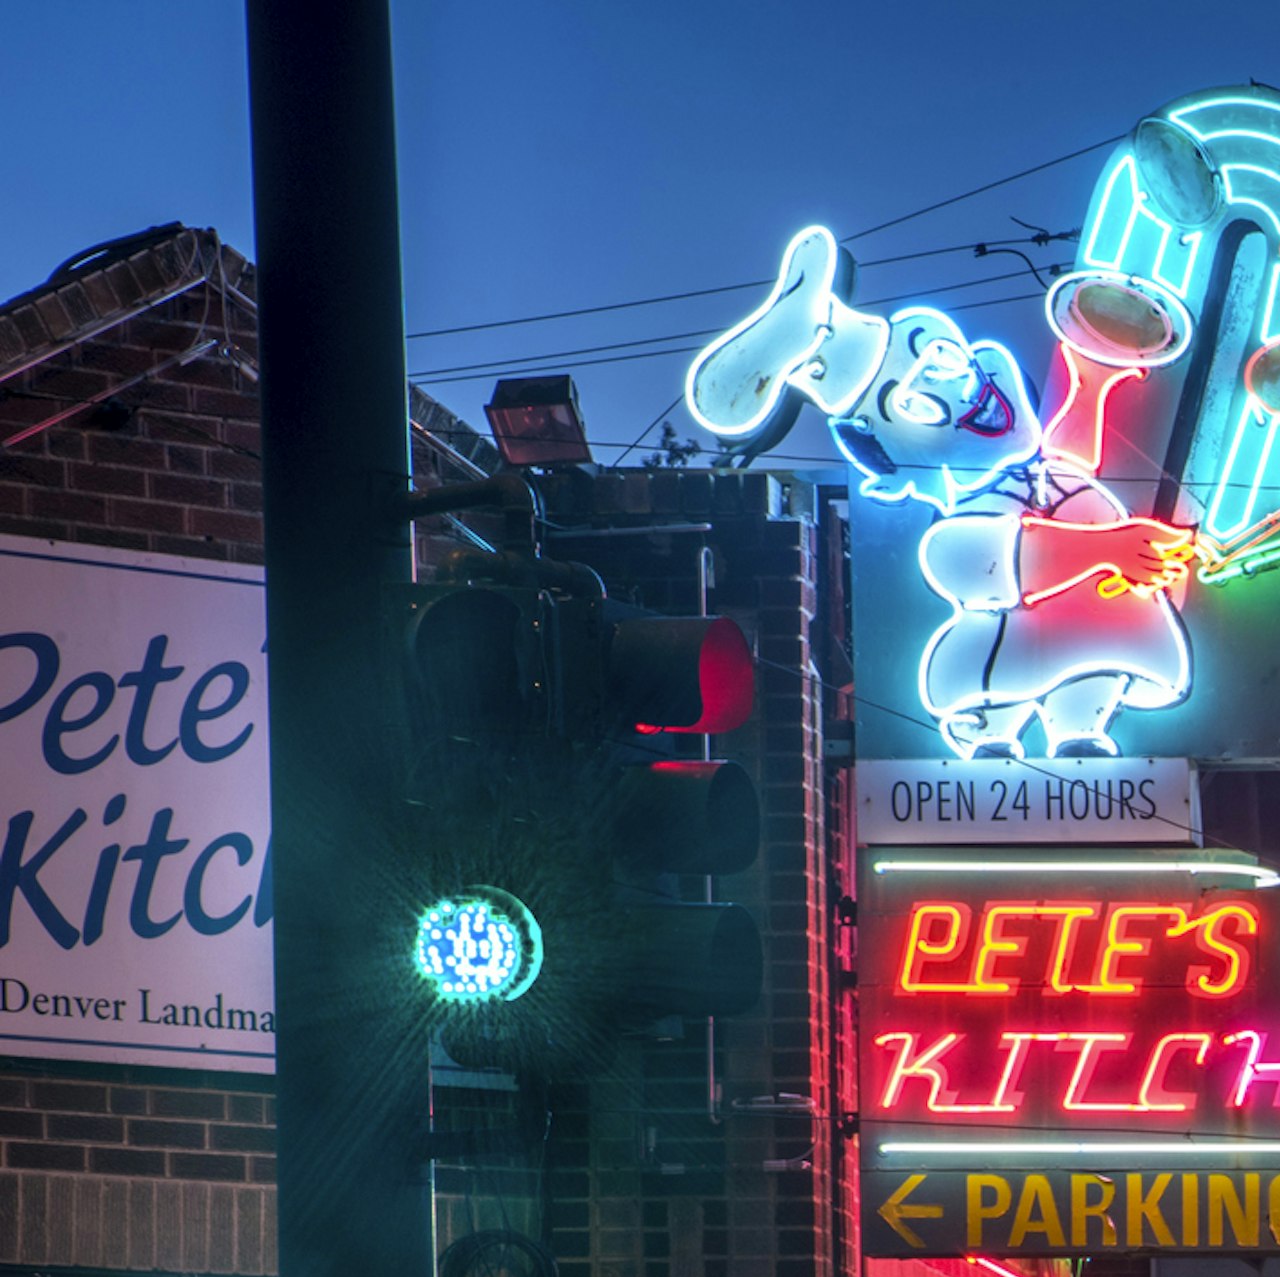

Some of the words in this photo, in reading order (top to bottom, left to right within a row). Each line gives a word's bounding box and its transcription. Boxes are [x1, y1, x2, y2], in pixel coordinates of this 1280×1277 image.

[891, 780, 977, 822] OPEN
[990, 780, 1031, 821] 24
[1045, 779, 1158, 821] HOURS
[0, 793, 273, 950] Kitc
[895, 900, 1259, 998] PETE'S
[0, 978, 126, 1021] Denver
